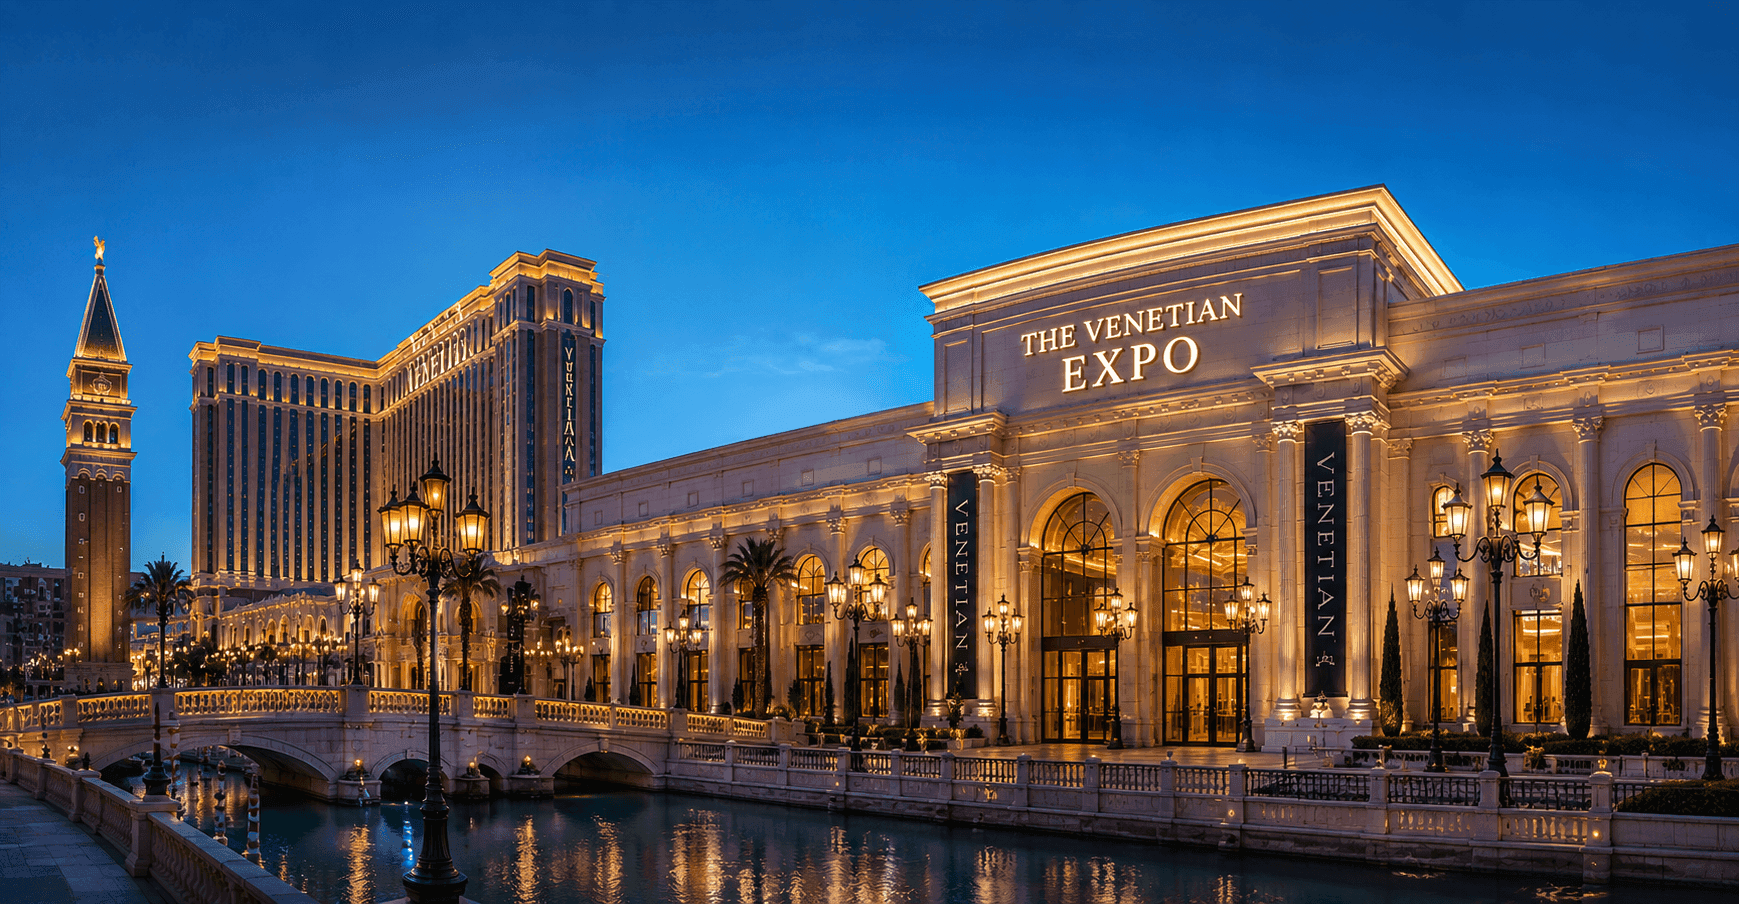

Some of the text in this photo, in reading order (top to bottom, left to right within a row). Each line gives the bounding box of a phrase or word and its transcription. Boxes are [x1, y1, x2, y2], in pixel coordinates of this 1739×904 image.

[1021, 293, 1243, 356] THE VENETIAN
[1061, 336, 1199, 393] EXPO
[955, 499, 969, 650] VENETIAN
[1316, 451, 1336, 636] VENETIAN
